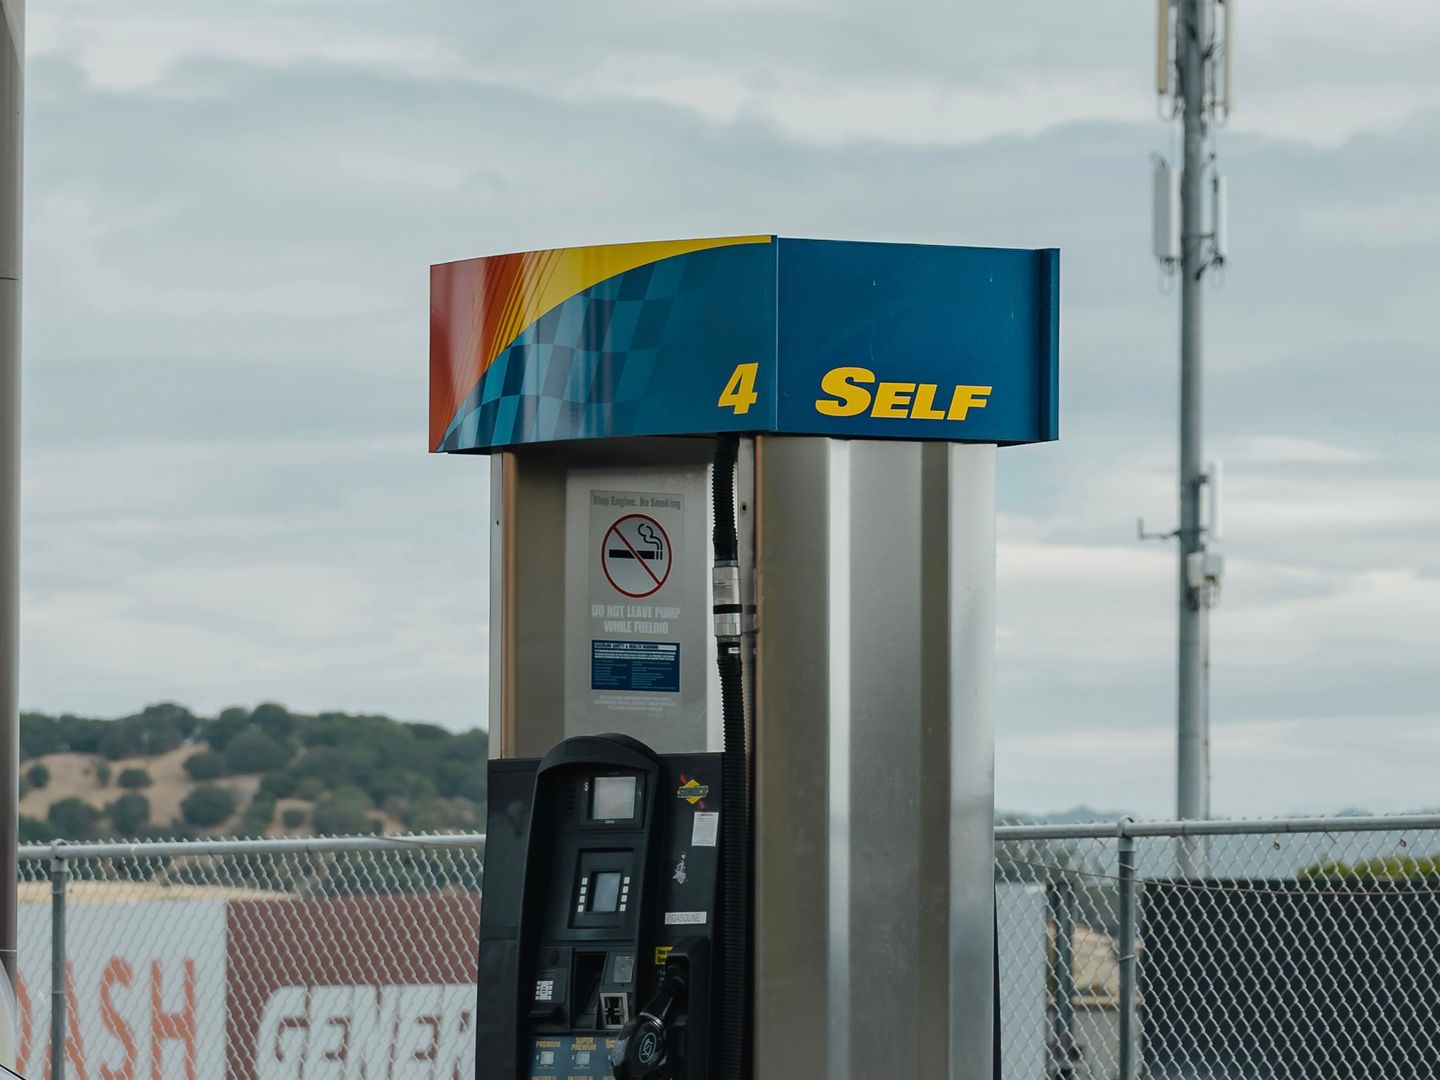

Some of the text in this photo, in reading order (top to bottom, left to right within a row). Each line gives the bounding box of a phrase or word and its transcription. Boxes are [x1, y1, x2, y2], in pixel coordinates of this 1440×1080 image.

[718, 362, 759, 414] 4
[815, 366, 992, 422] SELF
[650, 497, 681, 510] Smoking
[592, 604, 681, 619] DO NOT LEAVE PUMP
[603, 620, 669, 634] WHILE FUELING
